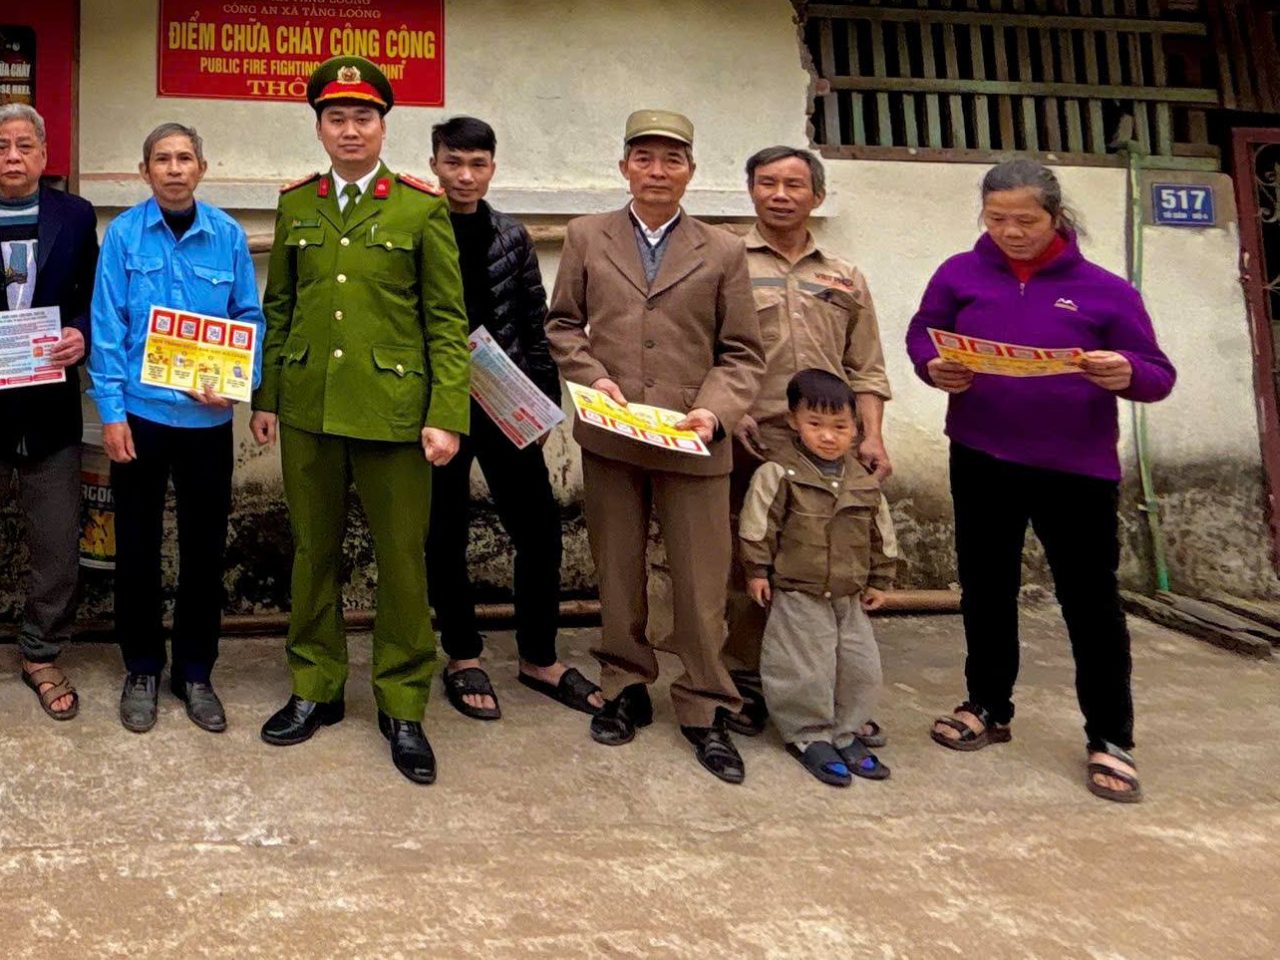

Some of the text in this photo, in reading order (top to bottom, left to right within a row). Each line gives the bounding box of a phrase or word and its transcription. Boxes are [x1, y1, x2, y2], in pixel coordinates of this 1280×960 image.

[223, 2, 257, 15] CÔNG
[260, 6, 278, 16] AN
[169, 11, 215, 51] ĐIỂM
[221, 18, 271, 54] CHỮA
[276, 21, 324, 55] CHÁY
[200, 57, 240, 74] PUBLIC
[243, 58, 267, 76] FIRE
[380, 63, 405, 80] OINT
[1161, 189, 1206, 210] 517
